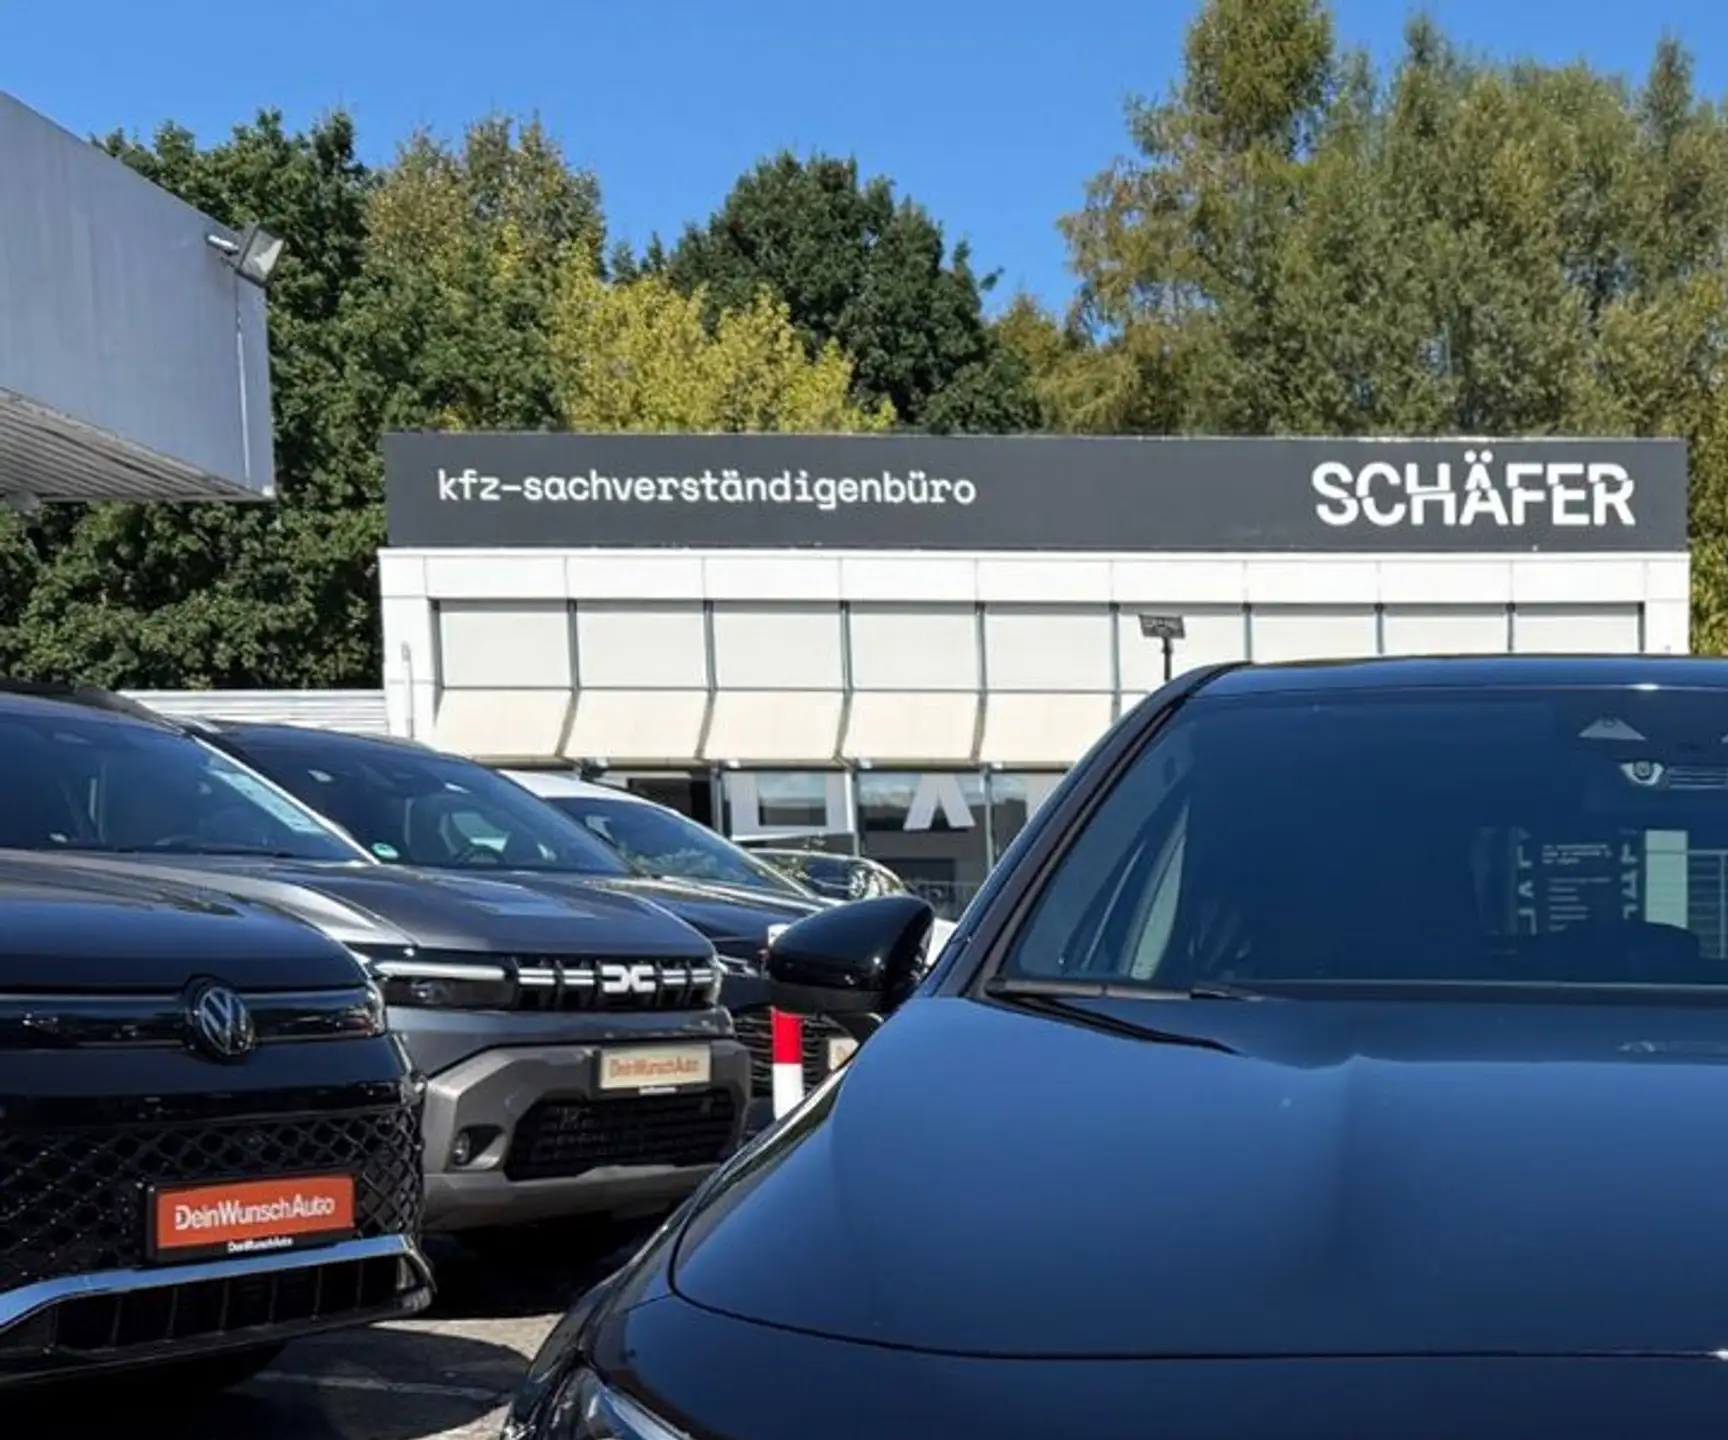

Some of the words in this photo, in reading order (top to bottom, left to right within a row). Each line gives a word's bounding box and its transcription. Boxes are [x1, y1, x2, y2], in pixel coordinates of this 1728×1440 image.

[437, 468, 977, 511] kfz-sachverständigenbüro
[1311, 450, 1635, 527] SCHÄFER
[174, 1193, 336, 1231] DeinWunschAuto
